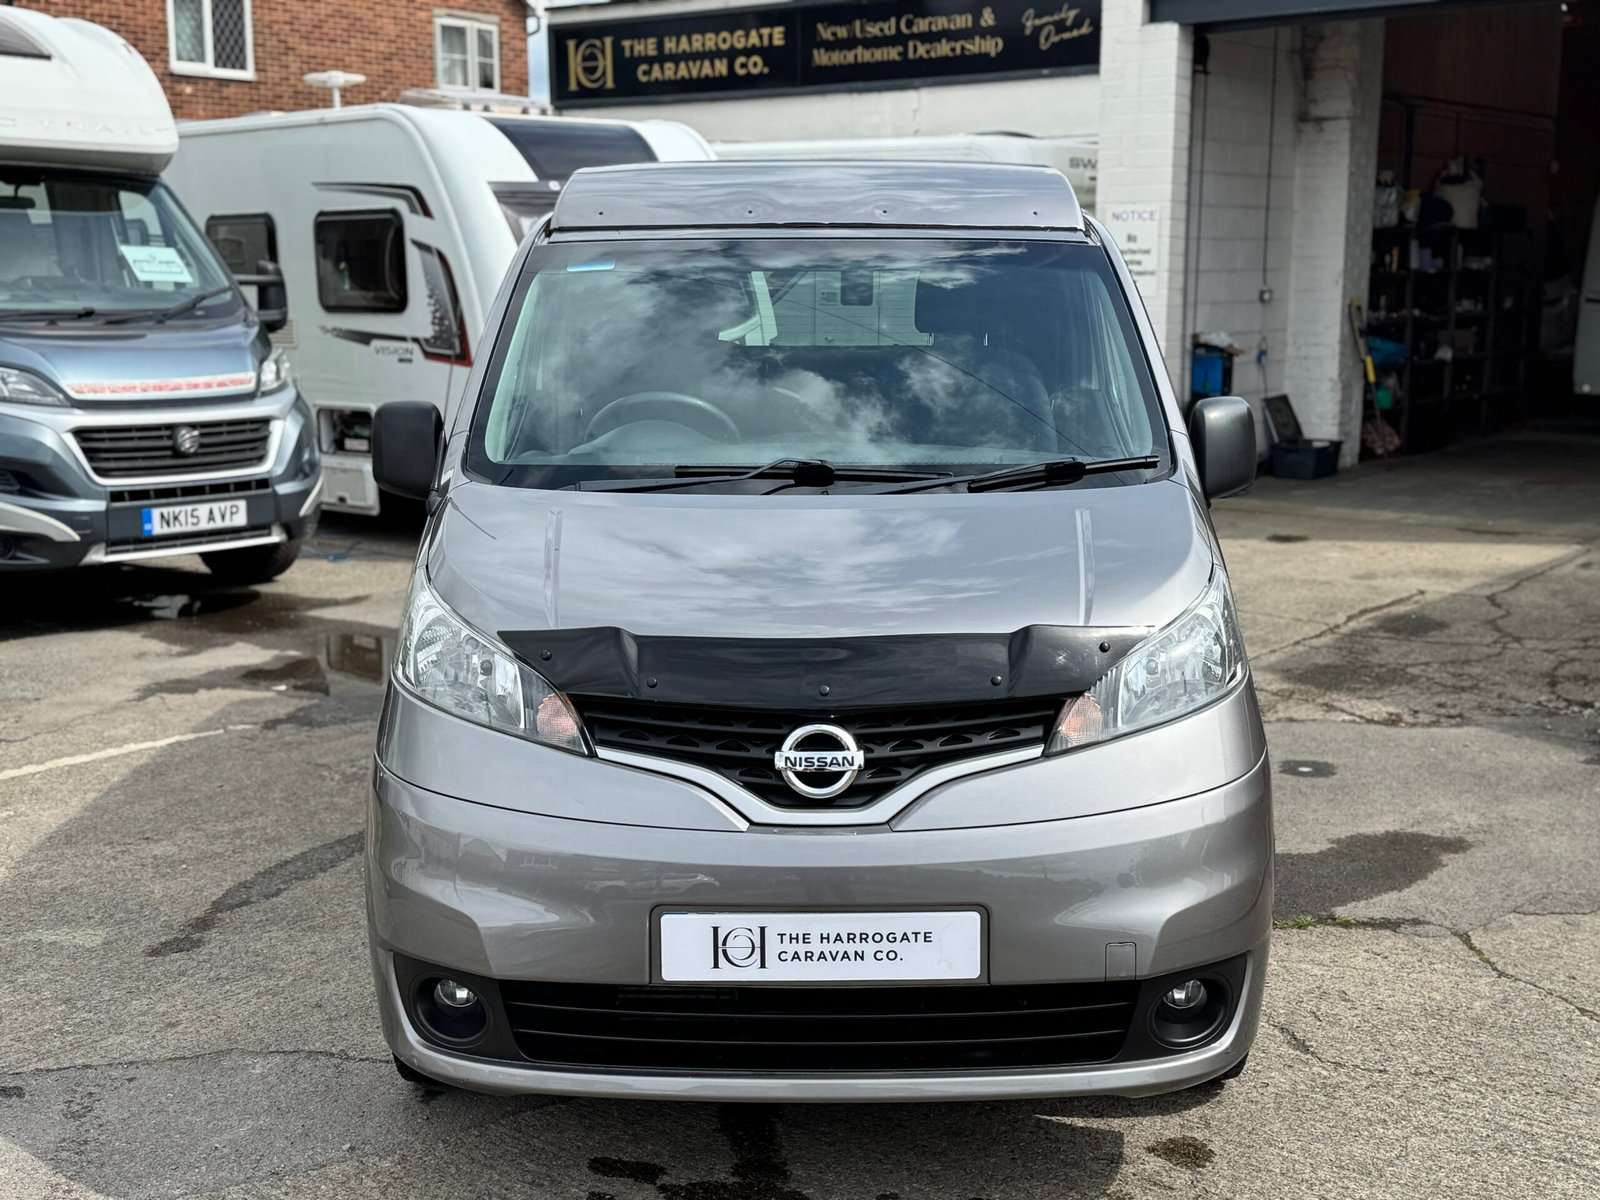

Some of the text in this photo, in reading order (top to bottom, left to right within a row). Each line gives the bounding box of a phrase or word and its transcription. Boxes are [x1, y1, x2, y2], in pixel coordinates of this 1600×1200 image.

[900, 12, 973, 34] Caravan
[980, 6, 995, 27] &
[621, 26, 785, 57] THE HARROGATE
[812, 34, 1003, 67] Motorhome Dealership
[637, 55, 769, 82] CARAVAN CO.
[1112, 210, 1156, 222] NOTICE
[160, 504, 240, 529] NK15 AVP
[784, 756, 854, 768] NISSAN
[777, 931, 934, 945] THE HARROGATE
[777, 950, 904, 962] CARAVAN CO.
